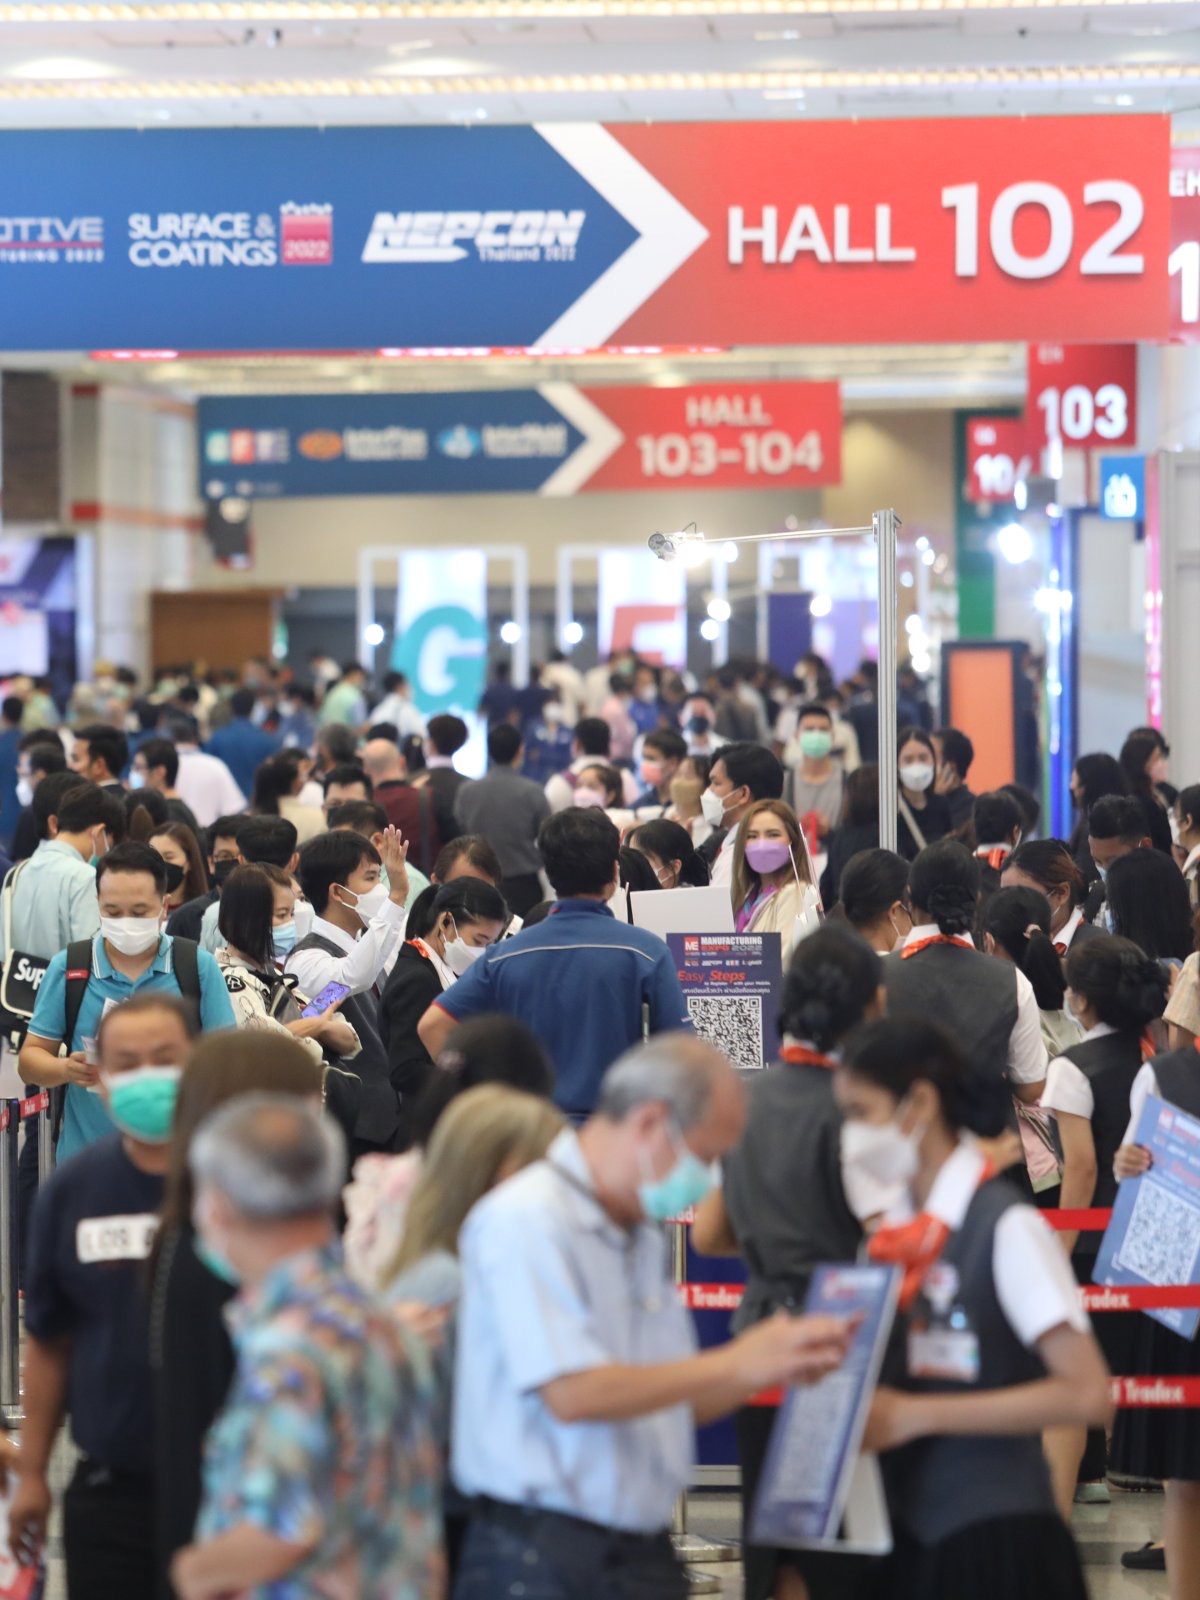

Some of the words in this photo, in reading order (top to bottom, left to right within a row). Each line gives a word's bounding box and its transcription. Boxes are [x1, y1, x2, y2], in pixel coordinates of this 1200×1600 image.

[128, 213, 251, 239] SURFACE
[254, 213, 275, 238] &
[362, 210, 586, 263] NEPCON
[727, 203, 917, 265] HALL
[941, 179, 1144, 279] 102
[128, 241, 277, 267] COATINGS
[685, 394, 773, 428] HALL
[1038, 384, 1128, 439] 103
[637, 430, 824, 478] 103-104
[701, 936, 762, 945] MANUFACTURING
[677, 970, 704, 983] Easy
[710, 970, 746, 983] Steps
